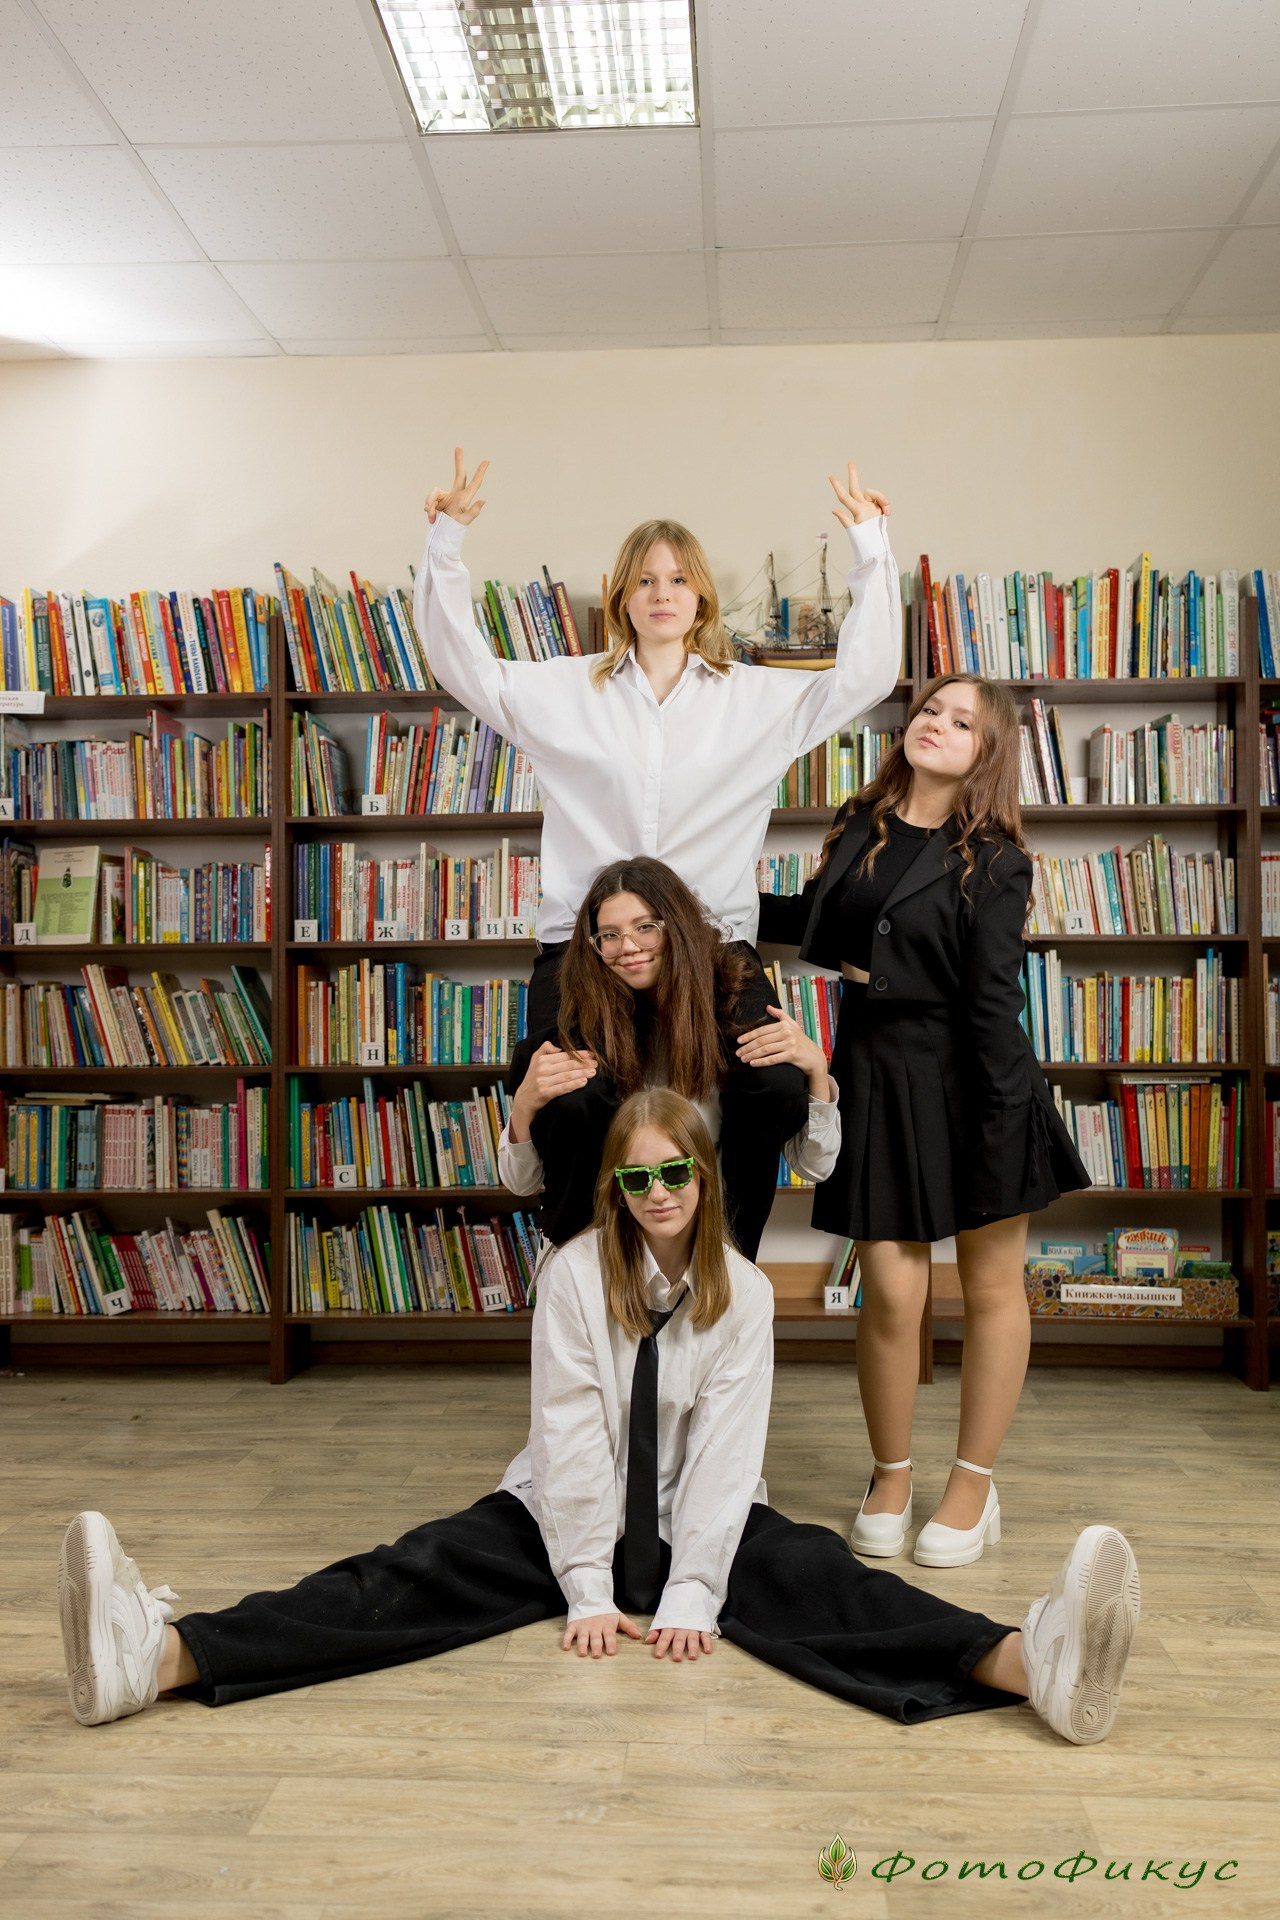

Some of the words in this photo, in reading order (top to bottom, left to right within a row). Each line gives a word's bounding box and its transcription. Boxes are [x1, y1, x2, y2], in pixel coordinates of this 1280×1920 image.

[369, 800, 380, 812] Б
[451, 924, 461, 936] З
[486, 924, 499, 935] И
[512, 923, 524, 935] К
[1071, 918, 1084, 930] Л
[19, 928, 31, 942] Д
[300, 926, 310, 938] Е
[378, 927, 394, 938] Ж
[367, 1048, 379, 1061] Н
[338, 1172, 350, 1184] С
[485, 1292, 503, 1306] Ш
[832, 1292, 842, 1303] Я
[1065, 1288, 1176, 1302] Книжки-малышки
[111, 1296, 124, 1309] Ч
